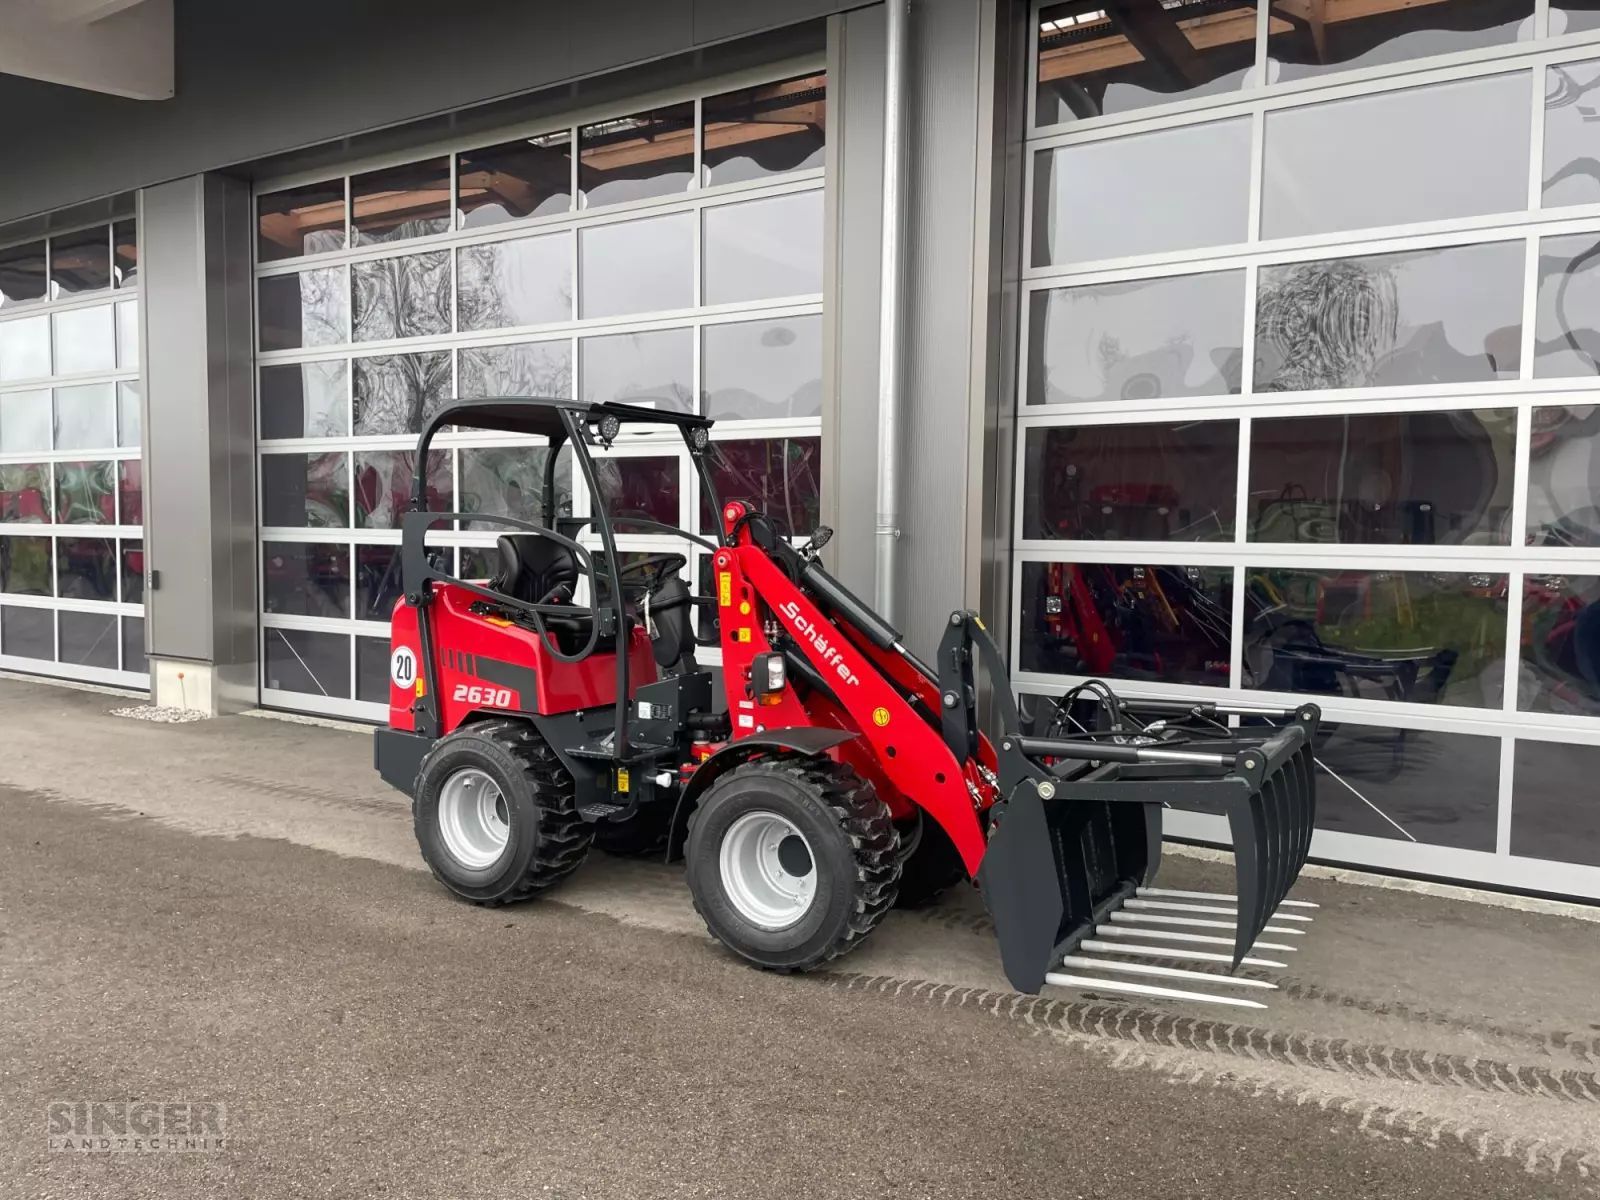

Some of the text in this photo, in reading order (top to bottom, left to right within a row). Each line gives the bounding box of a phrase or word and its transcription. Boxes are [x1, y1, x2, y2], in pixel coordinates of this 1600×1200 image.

[779, 601, 860, 686] Schäffer
[396, 655, 412, 681] 20
[453, 684, 511, 707] 2630
